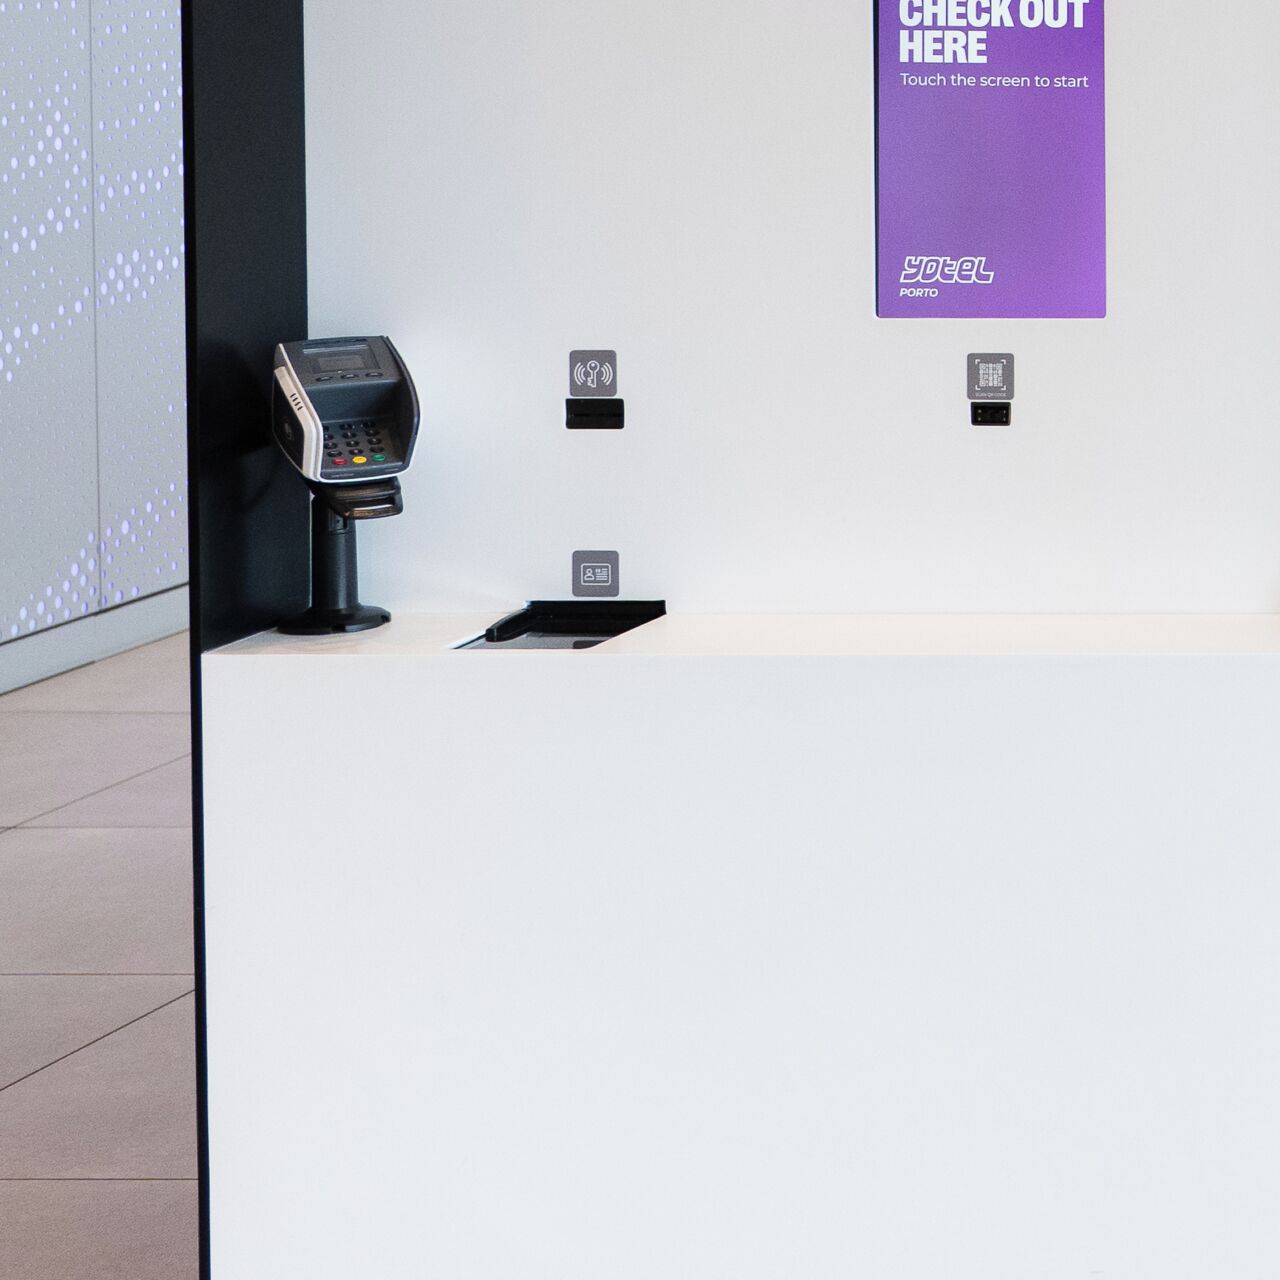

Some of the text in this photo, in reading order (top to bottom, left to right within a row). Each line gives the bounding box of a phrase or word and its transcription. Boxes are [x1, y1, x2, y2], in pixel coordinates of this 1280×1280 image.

[899, 29, 988, 64] HERE
[900, 73, 1089, 88] Touch the screen to start
[899, 288, 939, 297] PORTO
